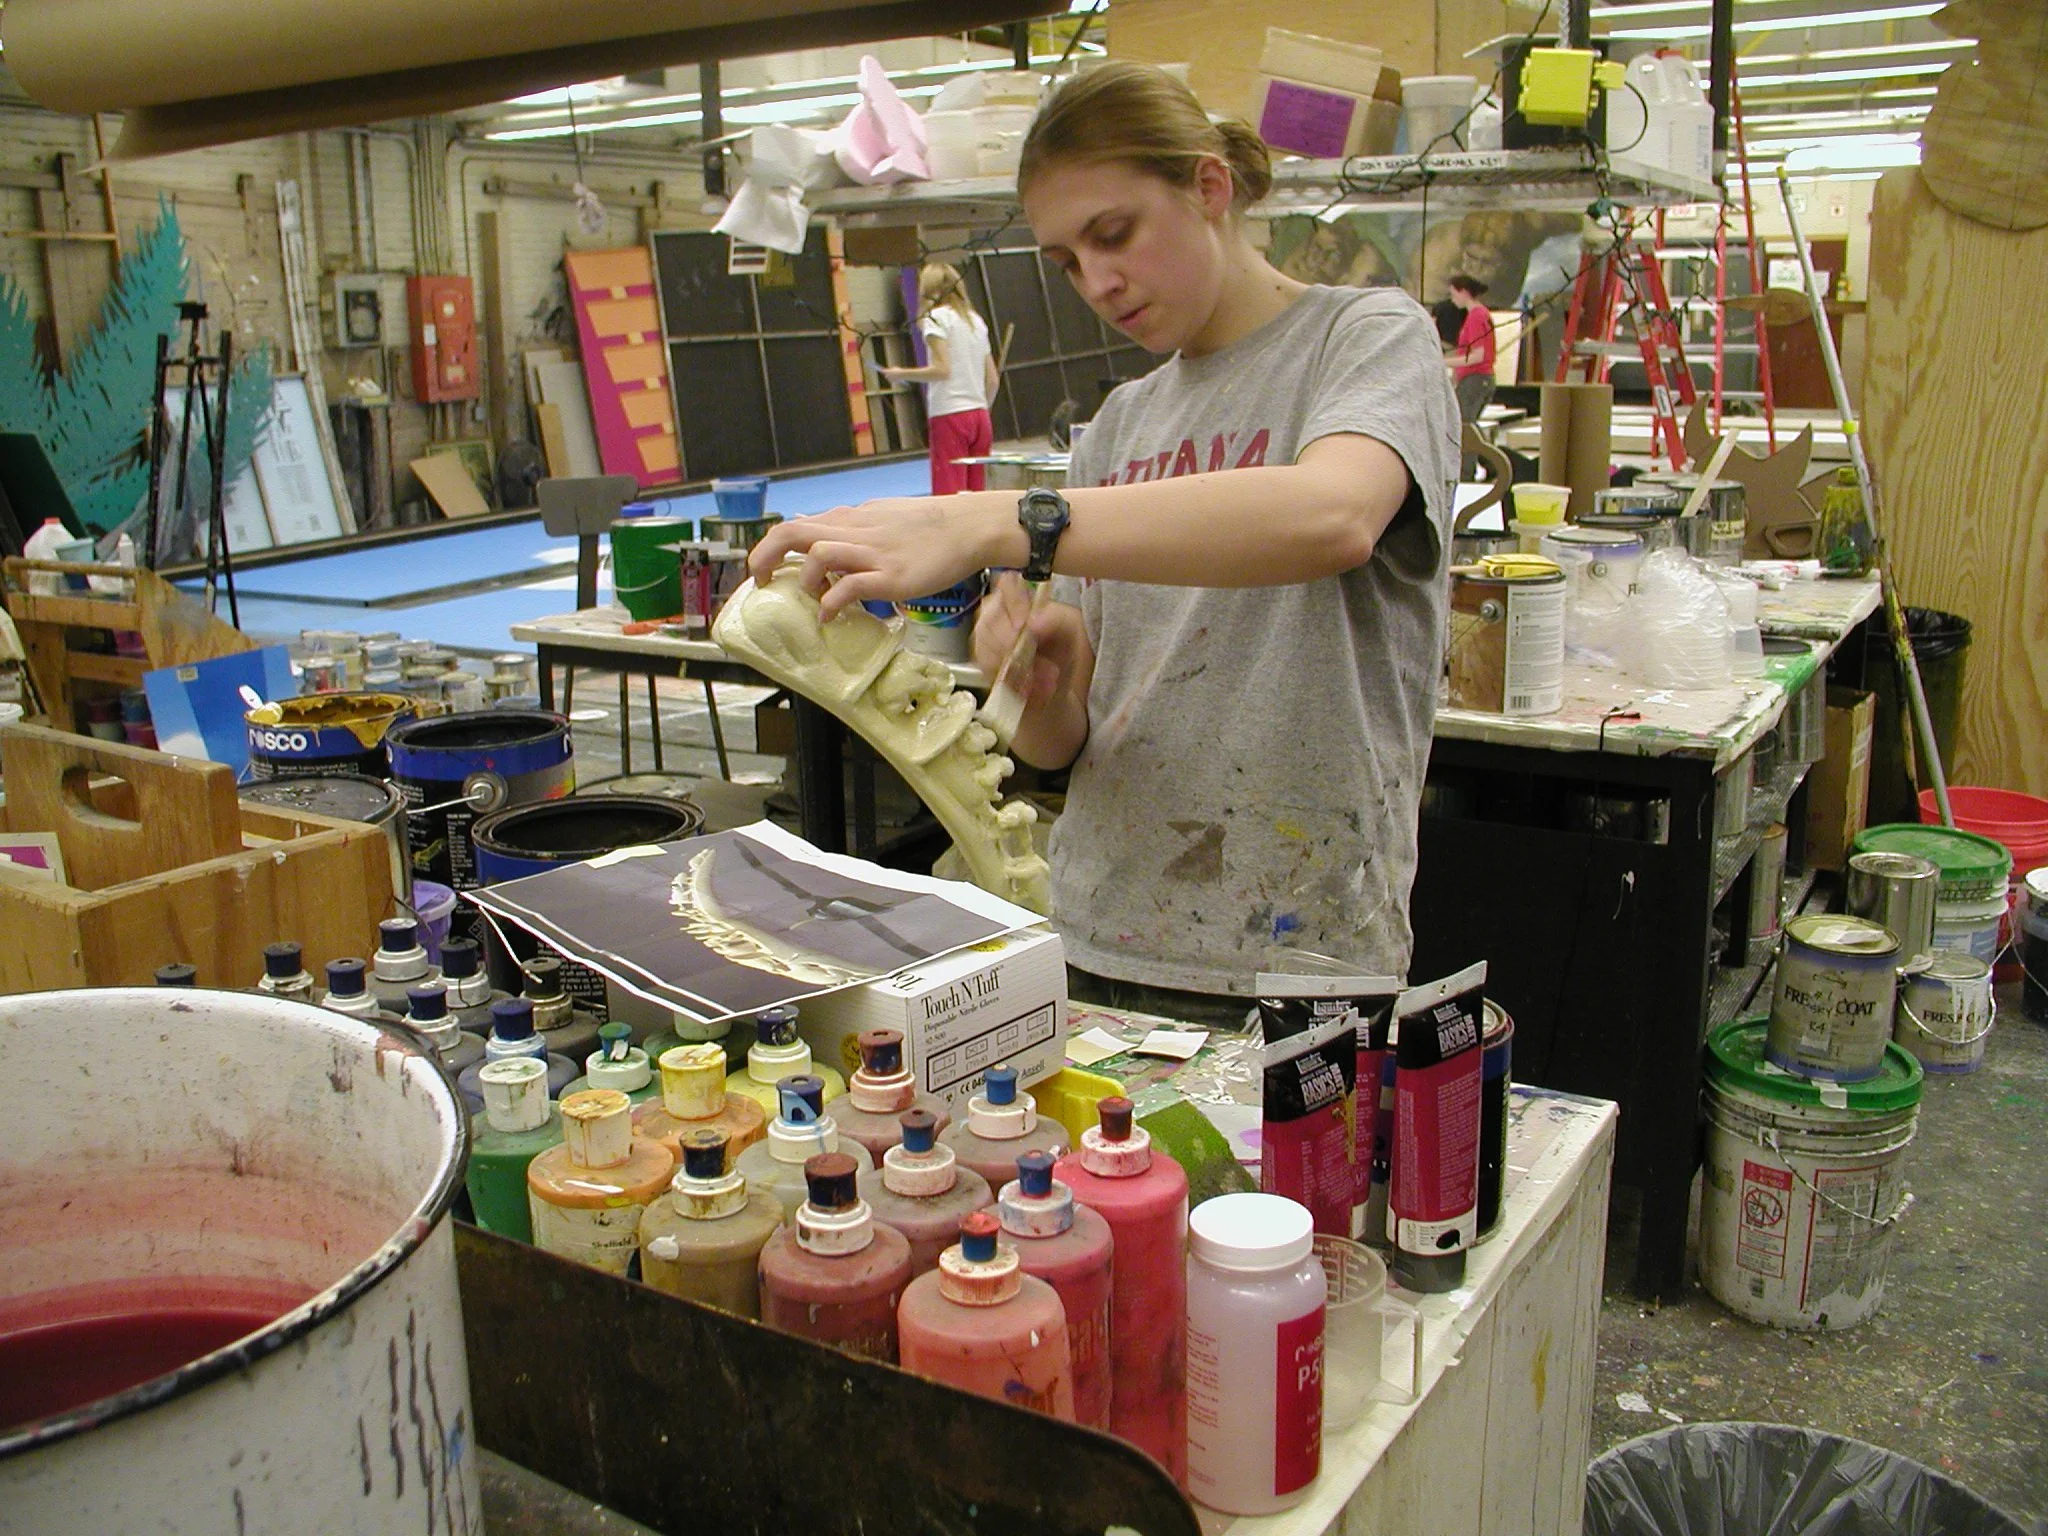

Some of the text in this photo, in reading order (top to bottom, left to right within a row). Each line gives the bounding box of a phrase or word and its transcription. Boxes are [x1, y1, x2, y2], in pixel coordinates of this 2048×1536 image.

[921, 968, 1000, 1019] Touch N Tuff
[1836, 998, 1877, 1016] COAT
[1923, 1009, 1963, 1022] FRES
